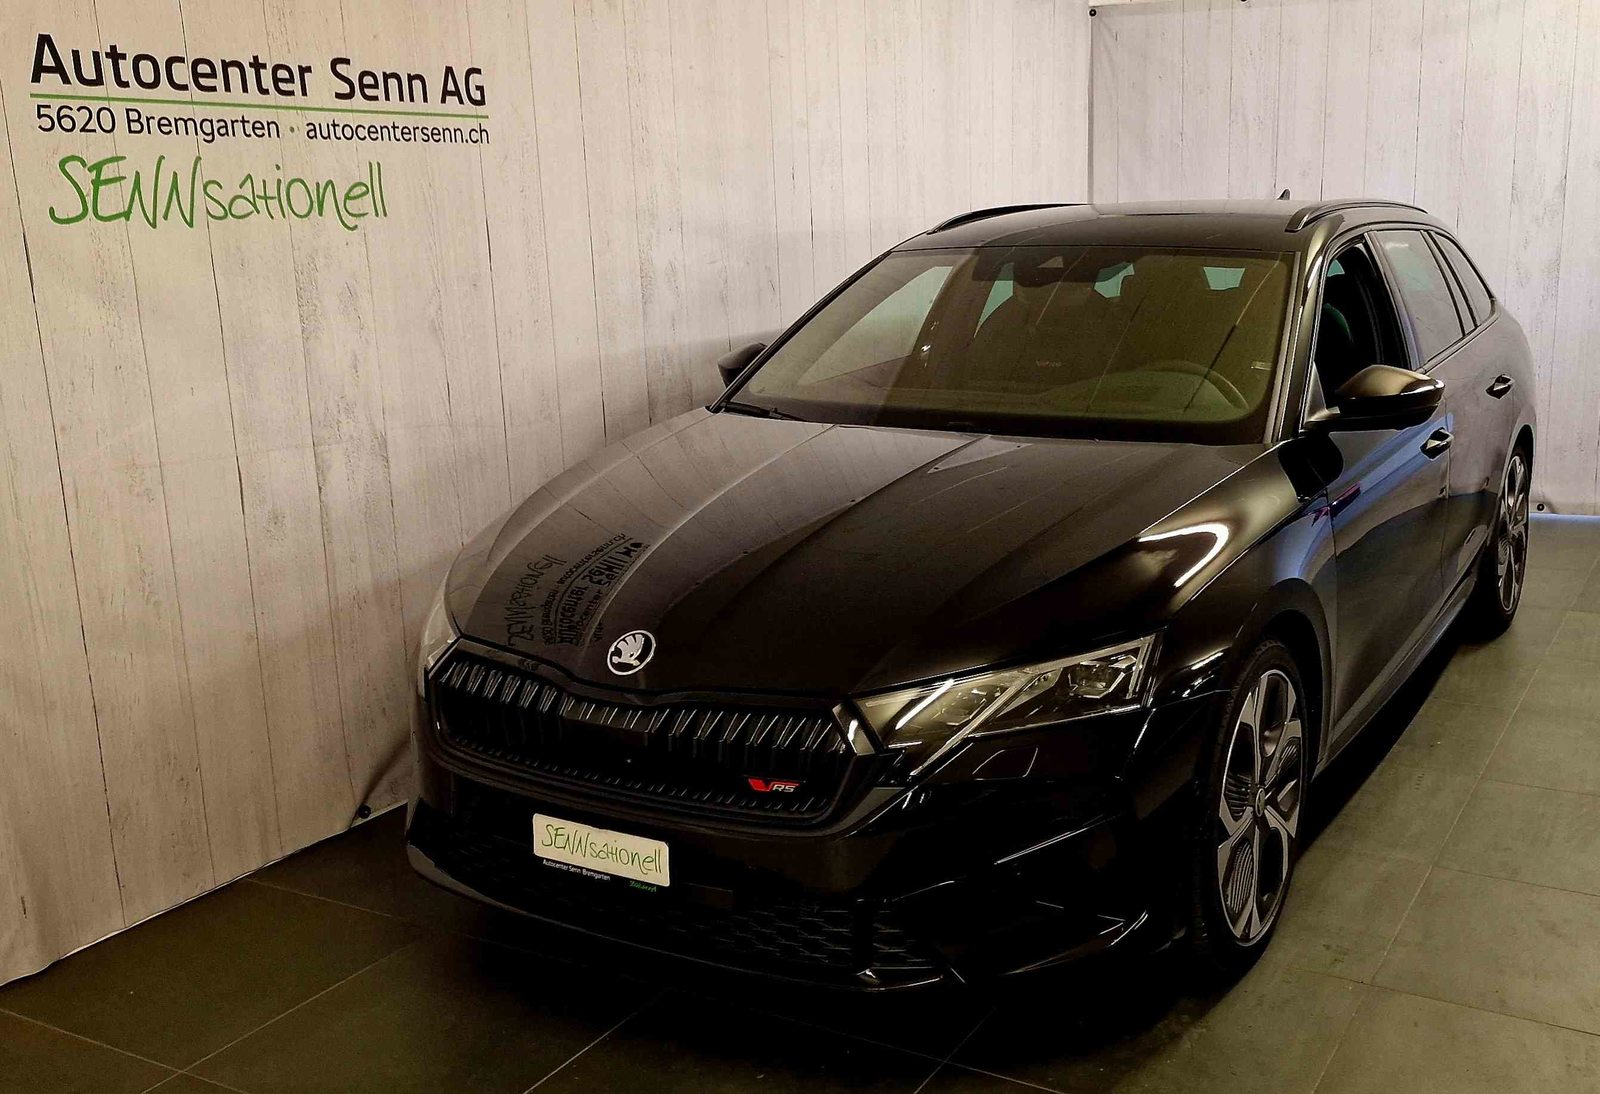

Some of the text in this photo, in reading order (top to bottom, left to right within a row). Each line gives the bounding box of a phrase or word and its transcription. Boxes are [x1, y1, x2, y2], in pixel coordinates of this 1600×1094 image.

[30, 33, 487, 107] Autocenter Senn AG
[36, 104, 490, 144] 5620 Bremgarten autocentersenn.ch
[48, 154, 388, 232] SENNsationell
[541, 823, 662, 875] SENNsationell
